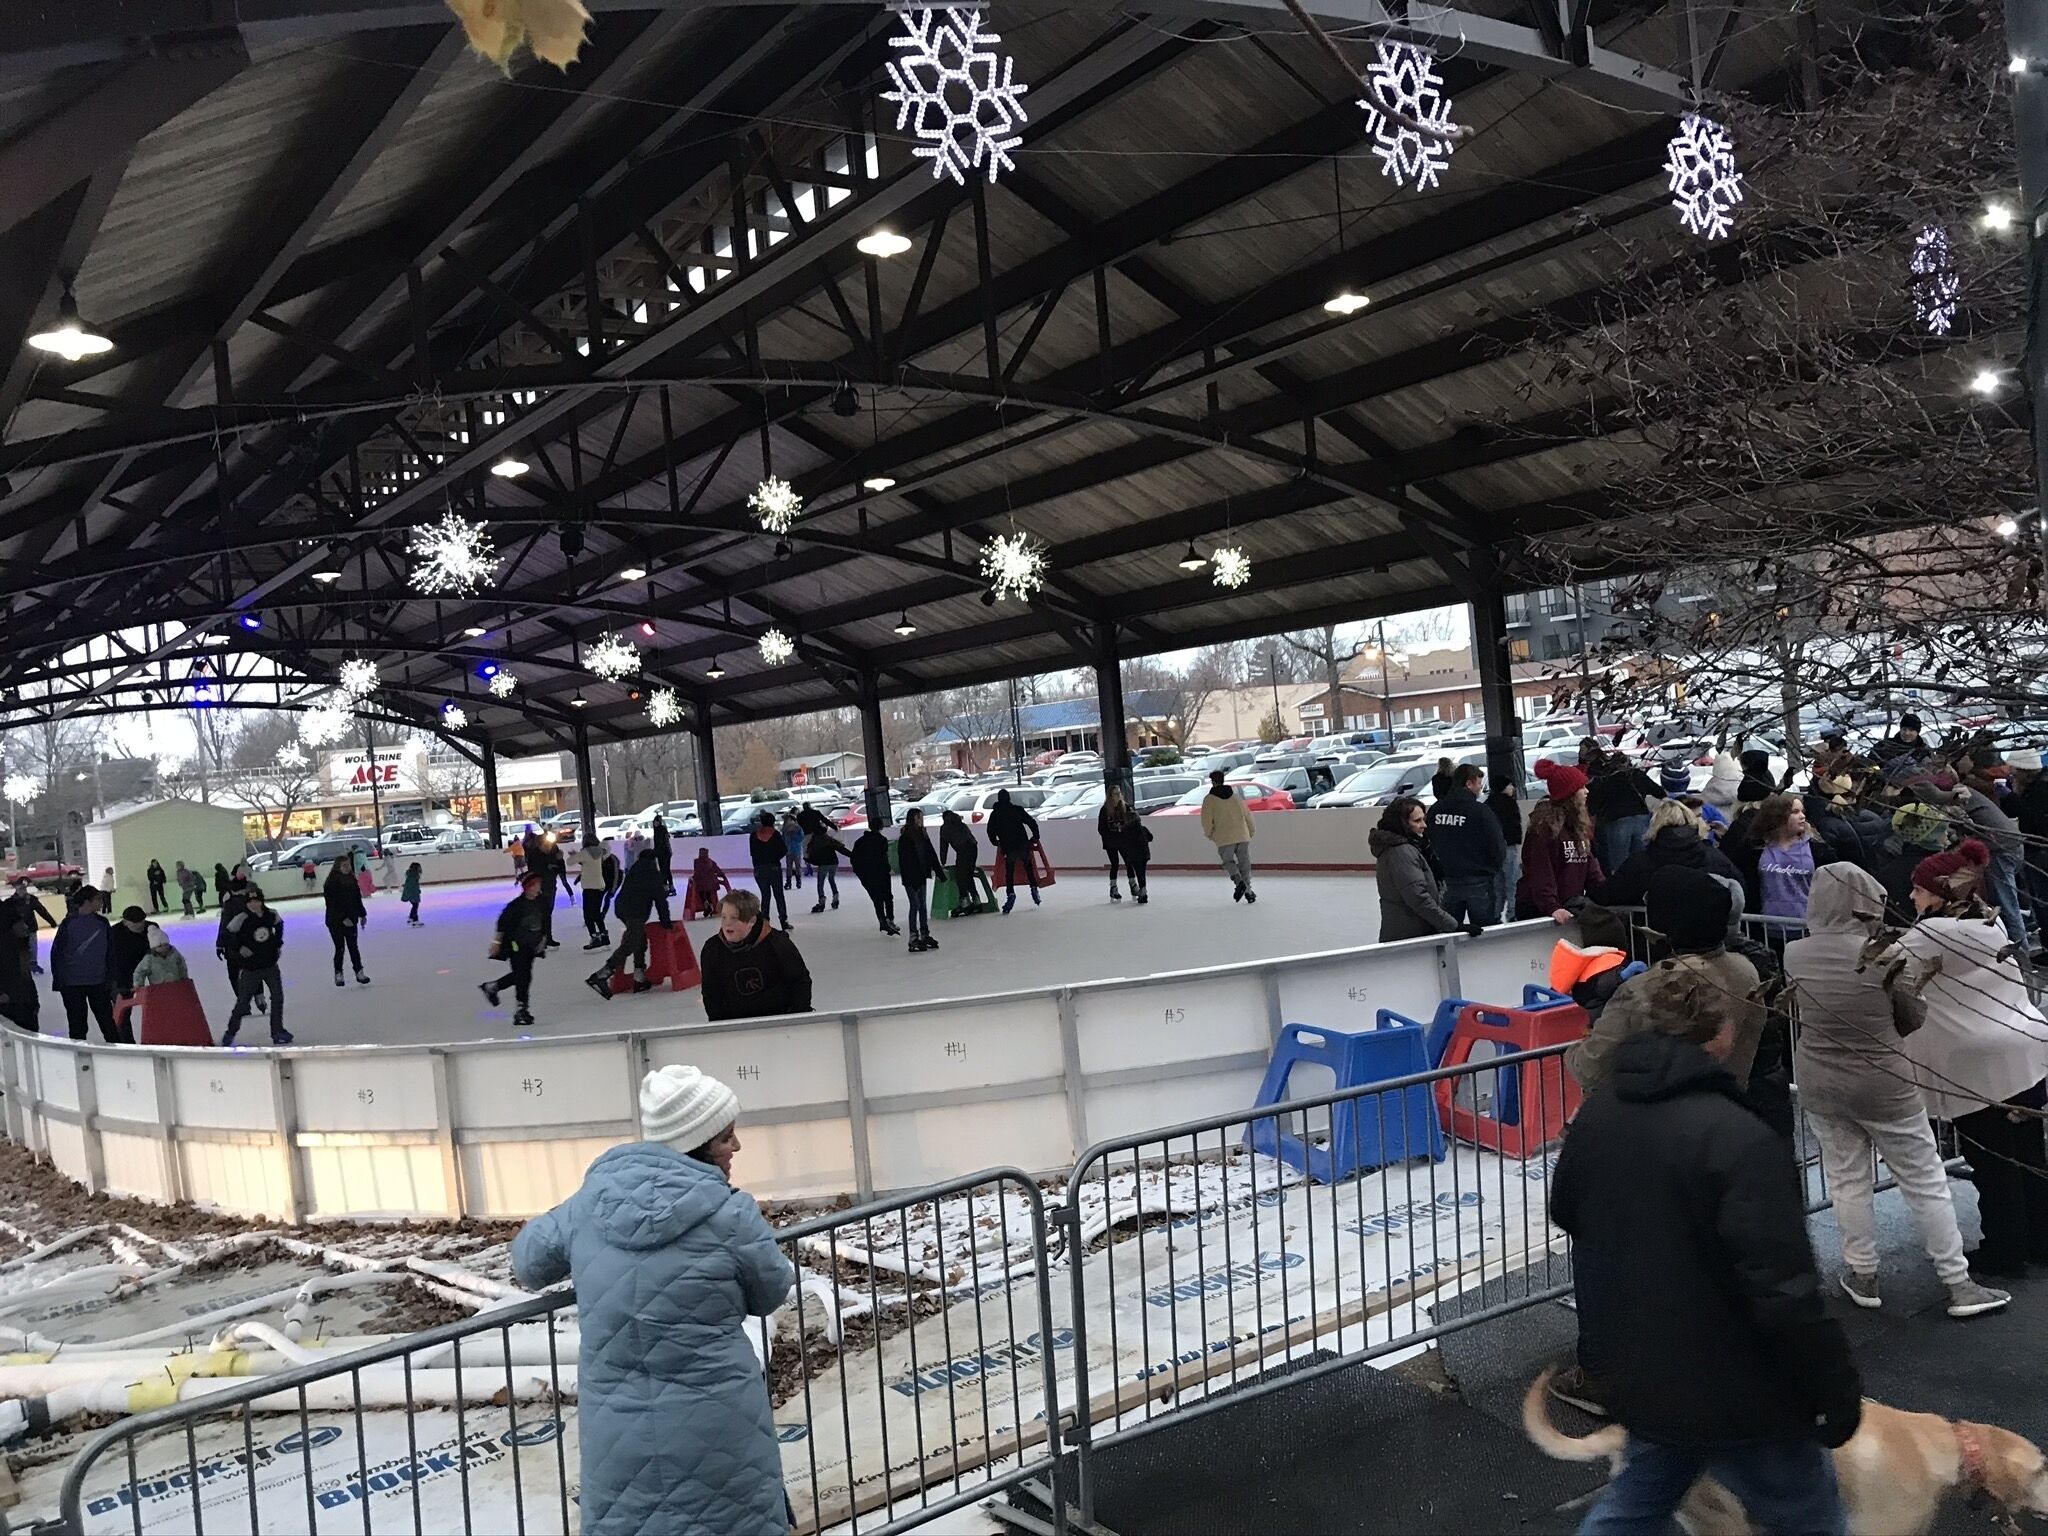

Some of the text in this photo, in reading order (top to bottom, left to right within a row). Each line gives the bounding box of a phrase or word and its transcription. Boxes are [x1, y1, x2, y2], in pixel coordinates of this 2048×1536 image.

[345, 753, 402, 764] WOLVERINE
[350, 764, 398, 784] ACE
[352, 783, 401, 792] Hardware
[1434, 813, 1467, 826] STAFF
[1347, 986, 1367, 1002] #5
[1165, 1008, 1185, 1024] #5
[944, 1042, 967, 1061] #4
[735, 1065, 761, 1080] #4
[522, 1078, 543, 1096] #3
[357, 1089, 374, 1105] #3
[889, 1343, 1038, 1397] BLOCK-IT
[1006, 1355, 1042, 1369] WRA
[346, 1430, 488, 1481] Kmbely-Clrk
[453, 1452, 506, 1474] WRAP
[87, 1444, 272, 1516] BLOCK-IT
[316, 1438, 500, 1510] BLOCK-IT
